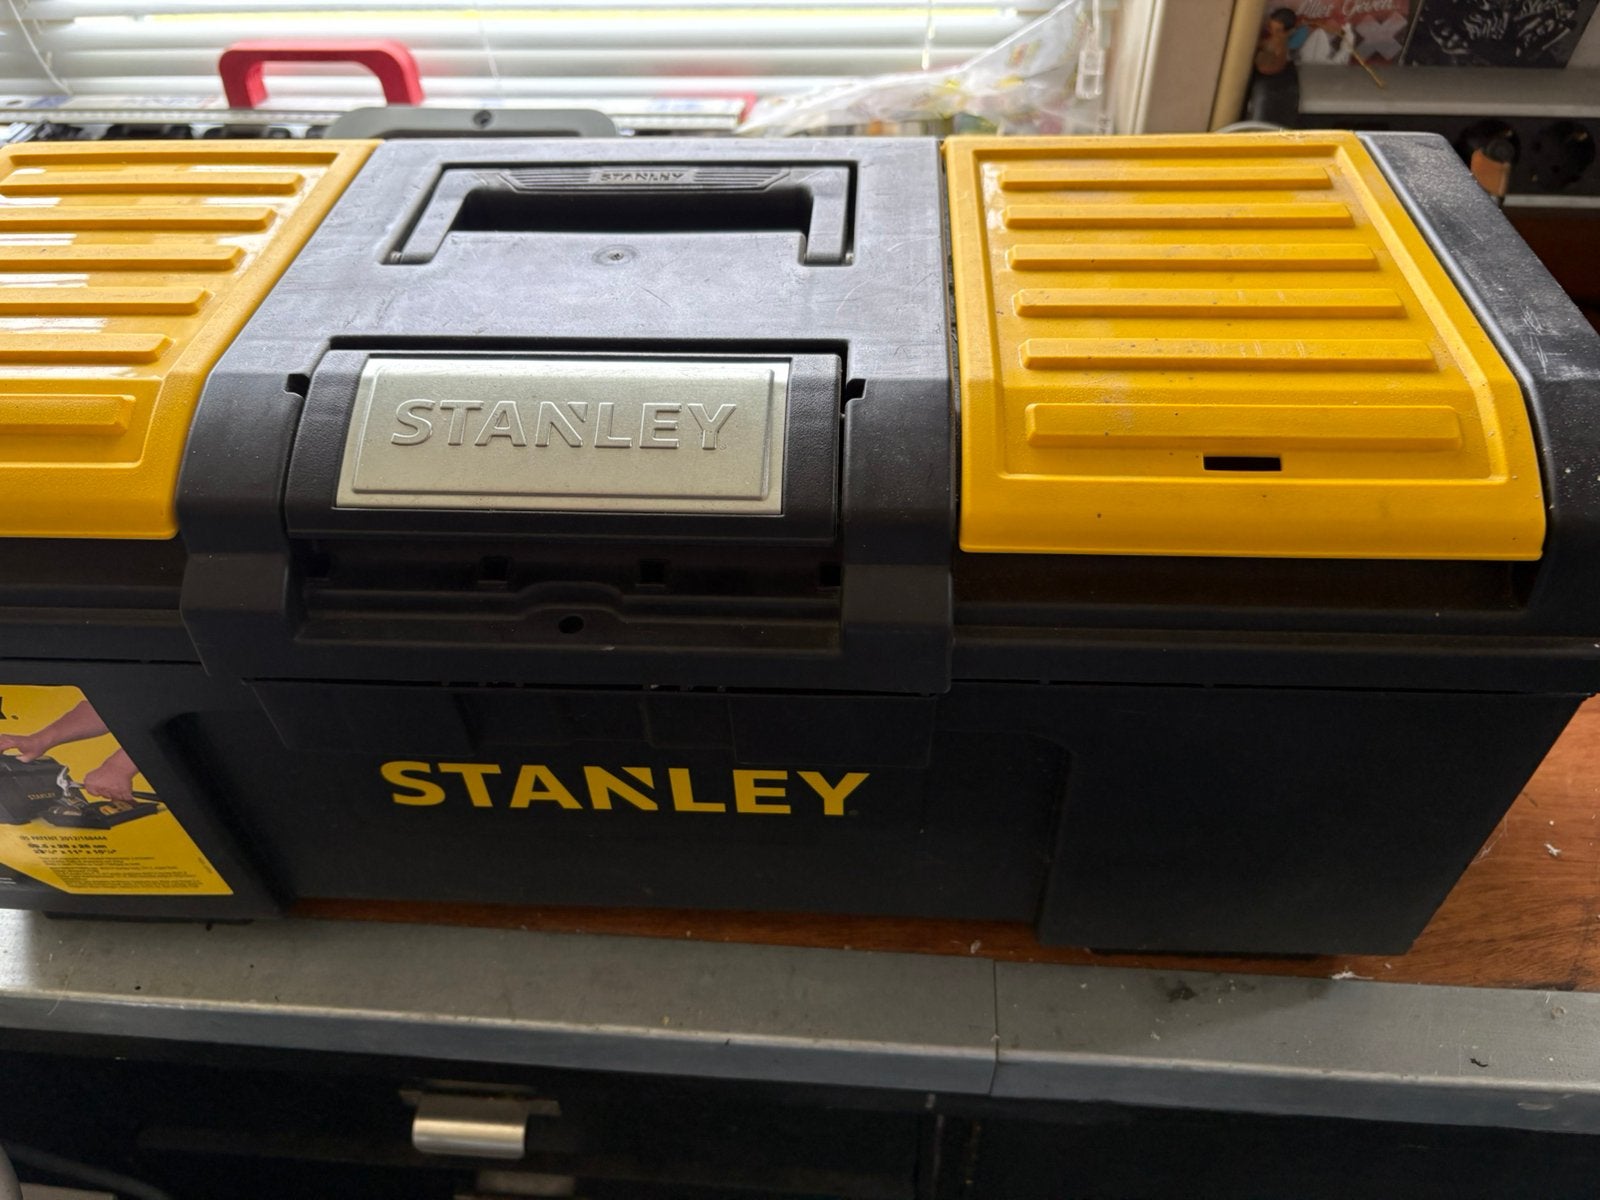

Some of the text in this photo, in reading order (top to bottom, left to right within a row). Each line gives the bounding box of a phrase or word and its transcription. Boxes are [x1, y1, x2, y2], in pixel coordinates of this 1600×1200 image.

[600, 172, 684, 181] STANLEY
[391, 398, 737, 450] STANLEY
[380, 760, 870, 816] STANLEY
